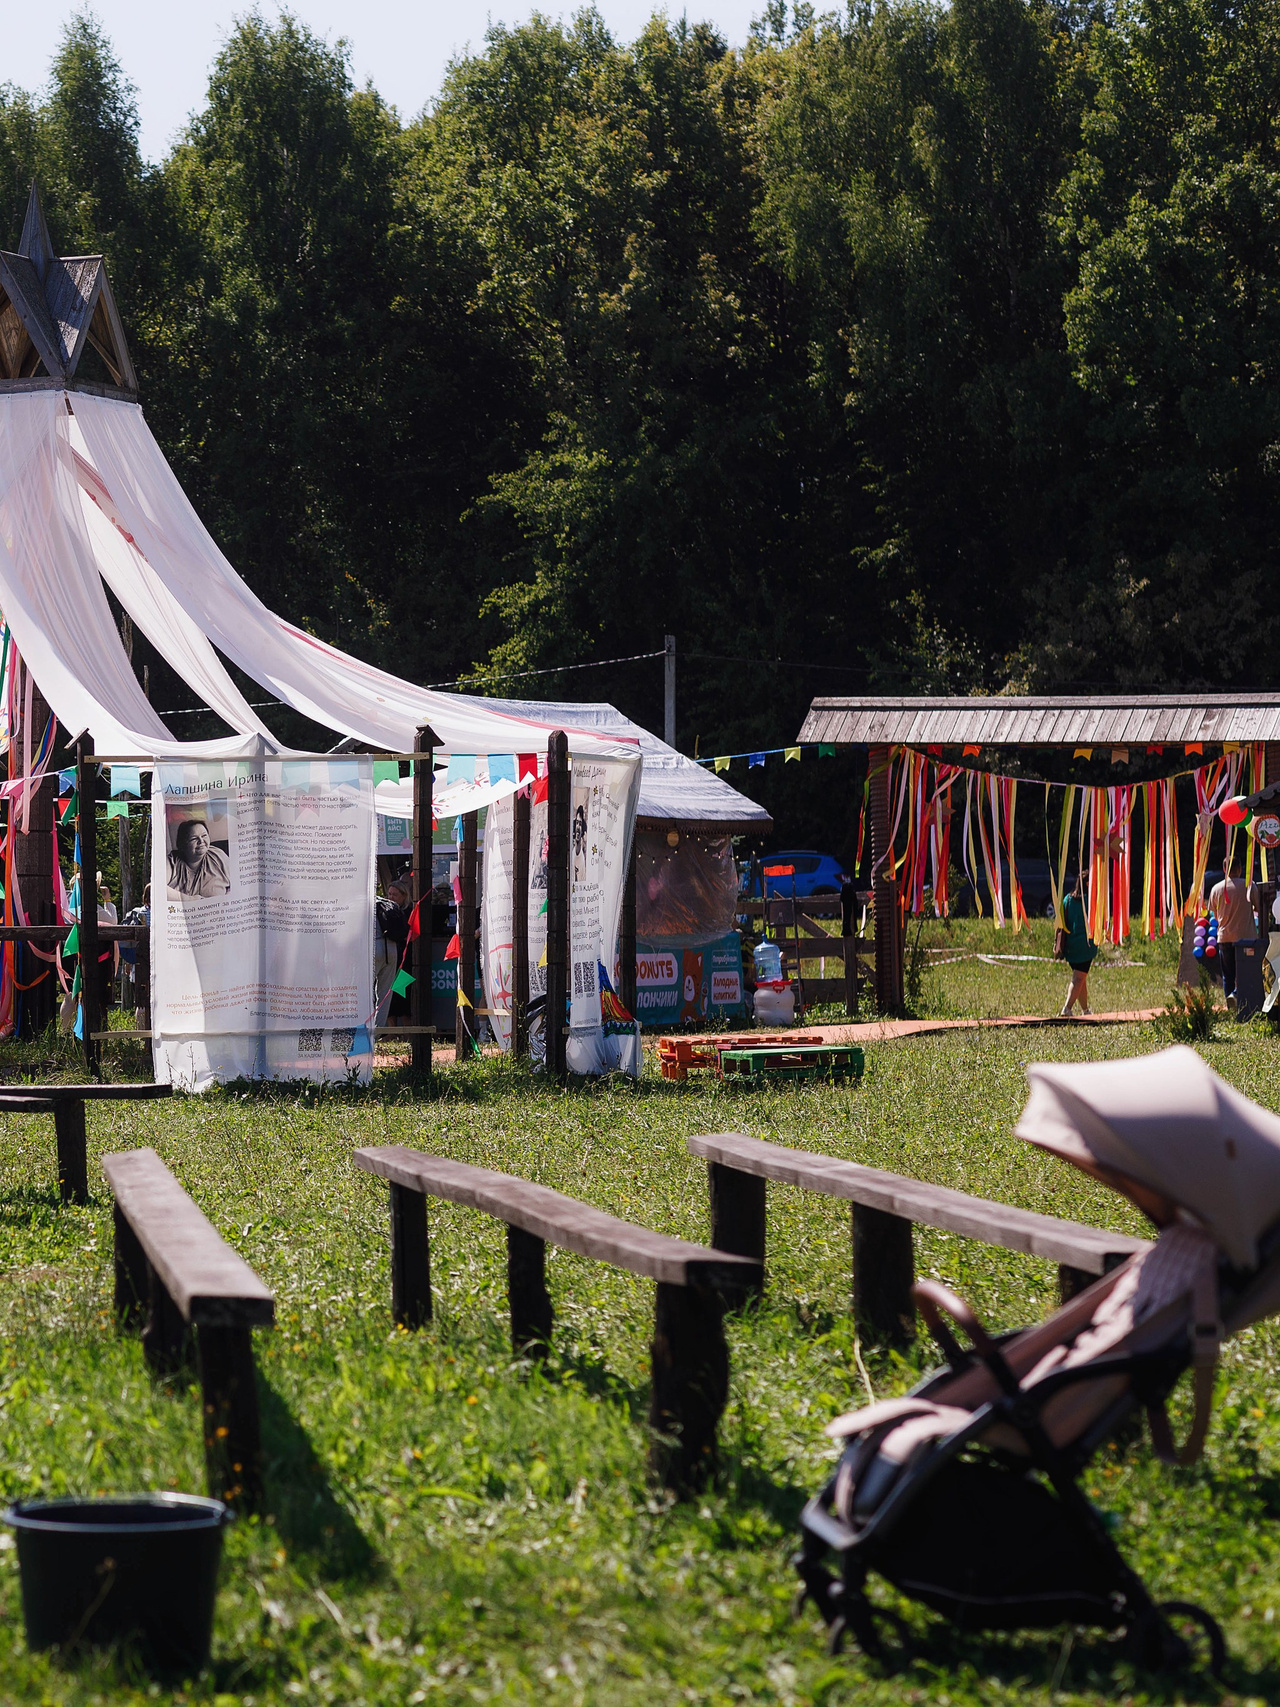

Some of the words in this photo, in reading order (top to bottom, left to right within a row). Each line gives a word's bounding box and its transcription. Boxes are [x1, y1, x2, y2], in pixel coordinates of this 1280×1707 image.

[165, 779, 223, 794] Лапшина
[228, 773, 269, 788] Ирина
[248, 820, 274, 828] помогаем
[191, 910, 219, 919] моментов
[191, 932, 219, 941] несмотря
[637, 990, 678, 1009] ПОНЧИКИ
